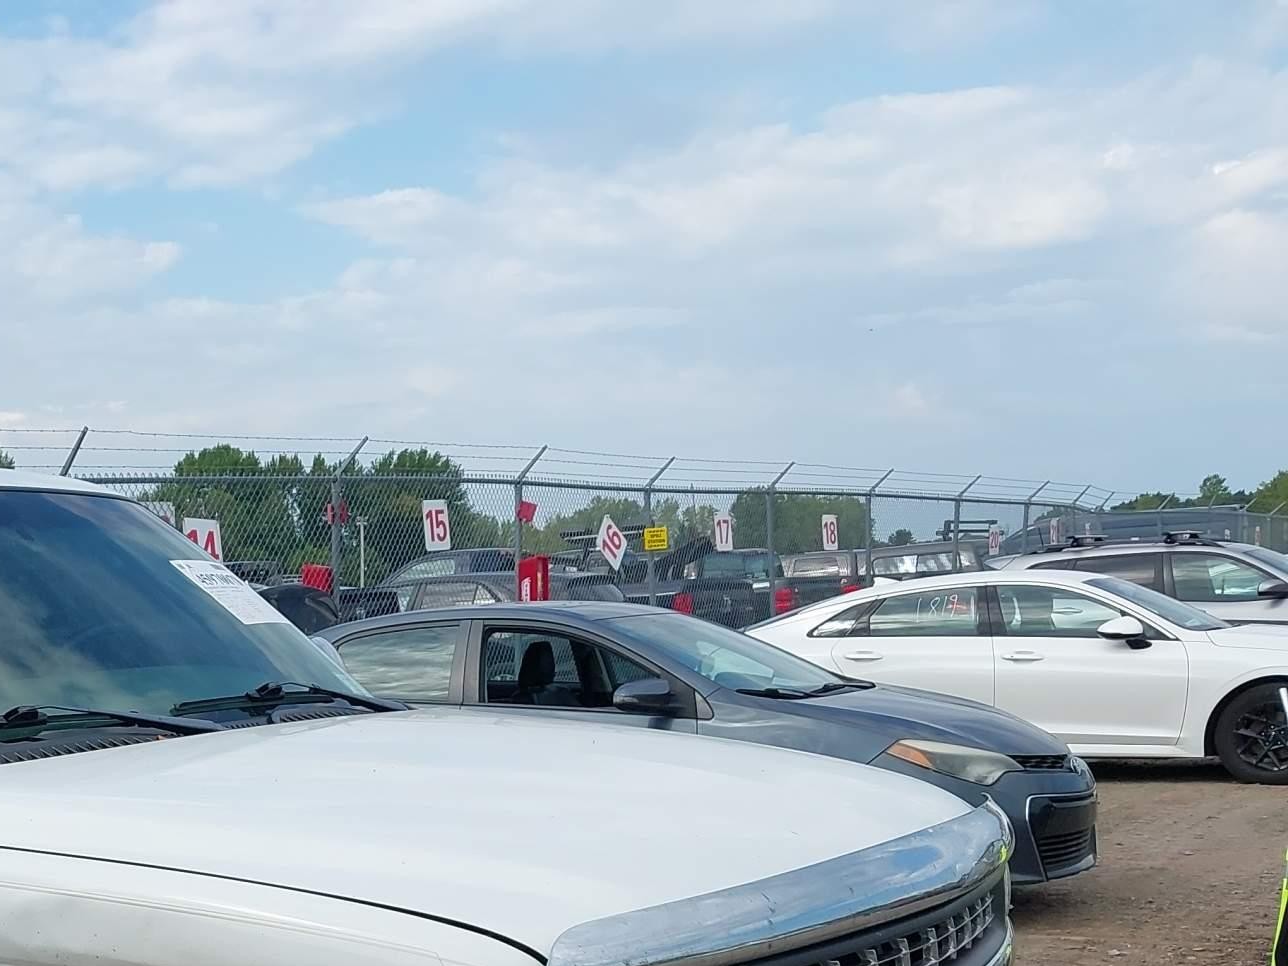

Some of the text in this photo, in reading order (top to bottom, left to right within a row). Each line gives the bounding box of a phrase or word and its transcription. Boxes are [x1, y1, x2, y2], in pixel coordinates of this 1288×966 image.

[425, 509, 448, 542] 15
[716, 519, 730, 544] 17
[823, 521, 836, 544] 18
[601, 524, 623, 560] 16
[990, 530, 1000, 549] 20
